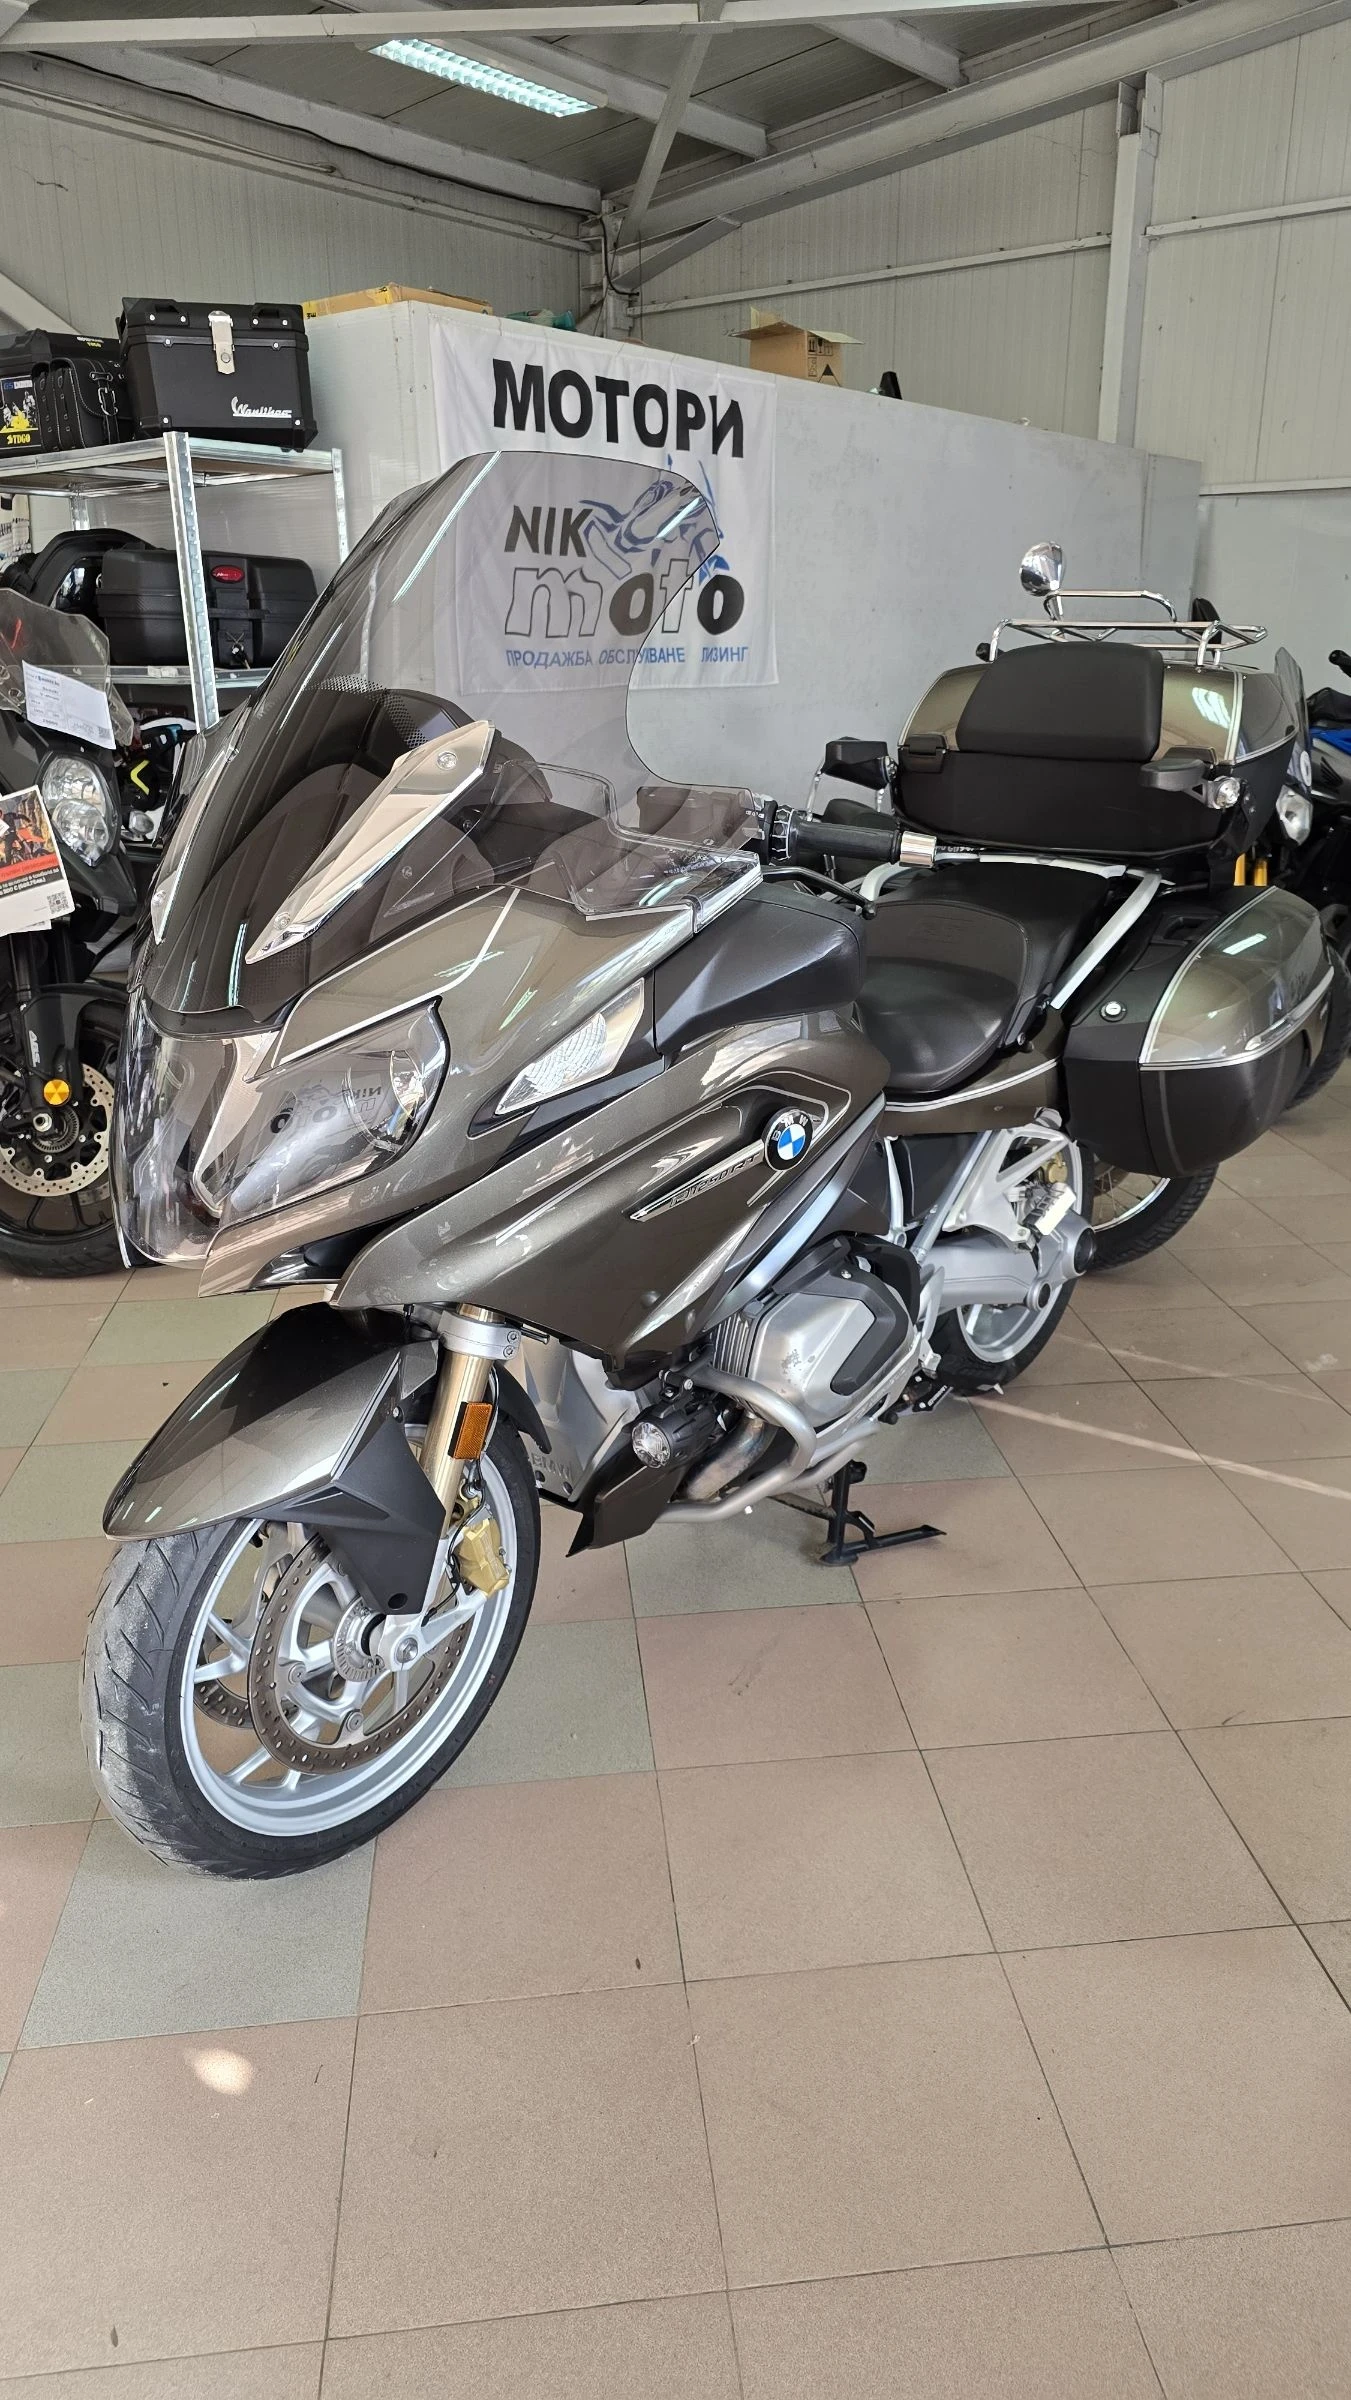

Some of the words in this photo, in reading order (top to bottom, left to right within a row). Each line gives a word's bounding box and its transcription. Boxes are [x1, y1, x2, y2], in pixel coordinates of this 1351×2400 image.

[492, 358, 744, 458] МОТОРИ
[504, 505, 593, 558] NIK
[504, 558, 745, 639] moto
[505, 648, 593, 669] ПРОДАЖБА
[701, 646, 749, 663] ЛИЗИНГ
[771, 1114, 809, 1141] BMW
